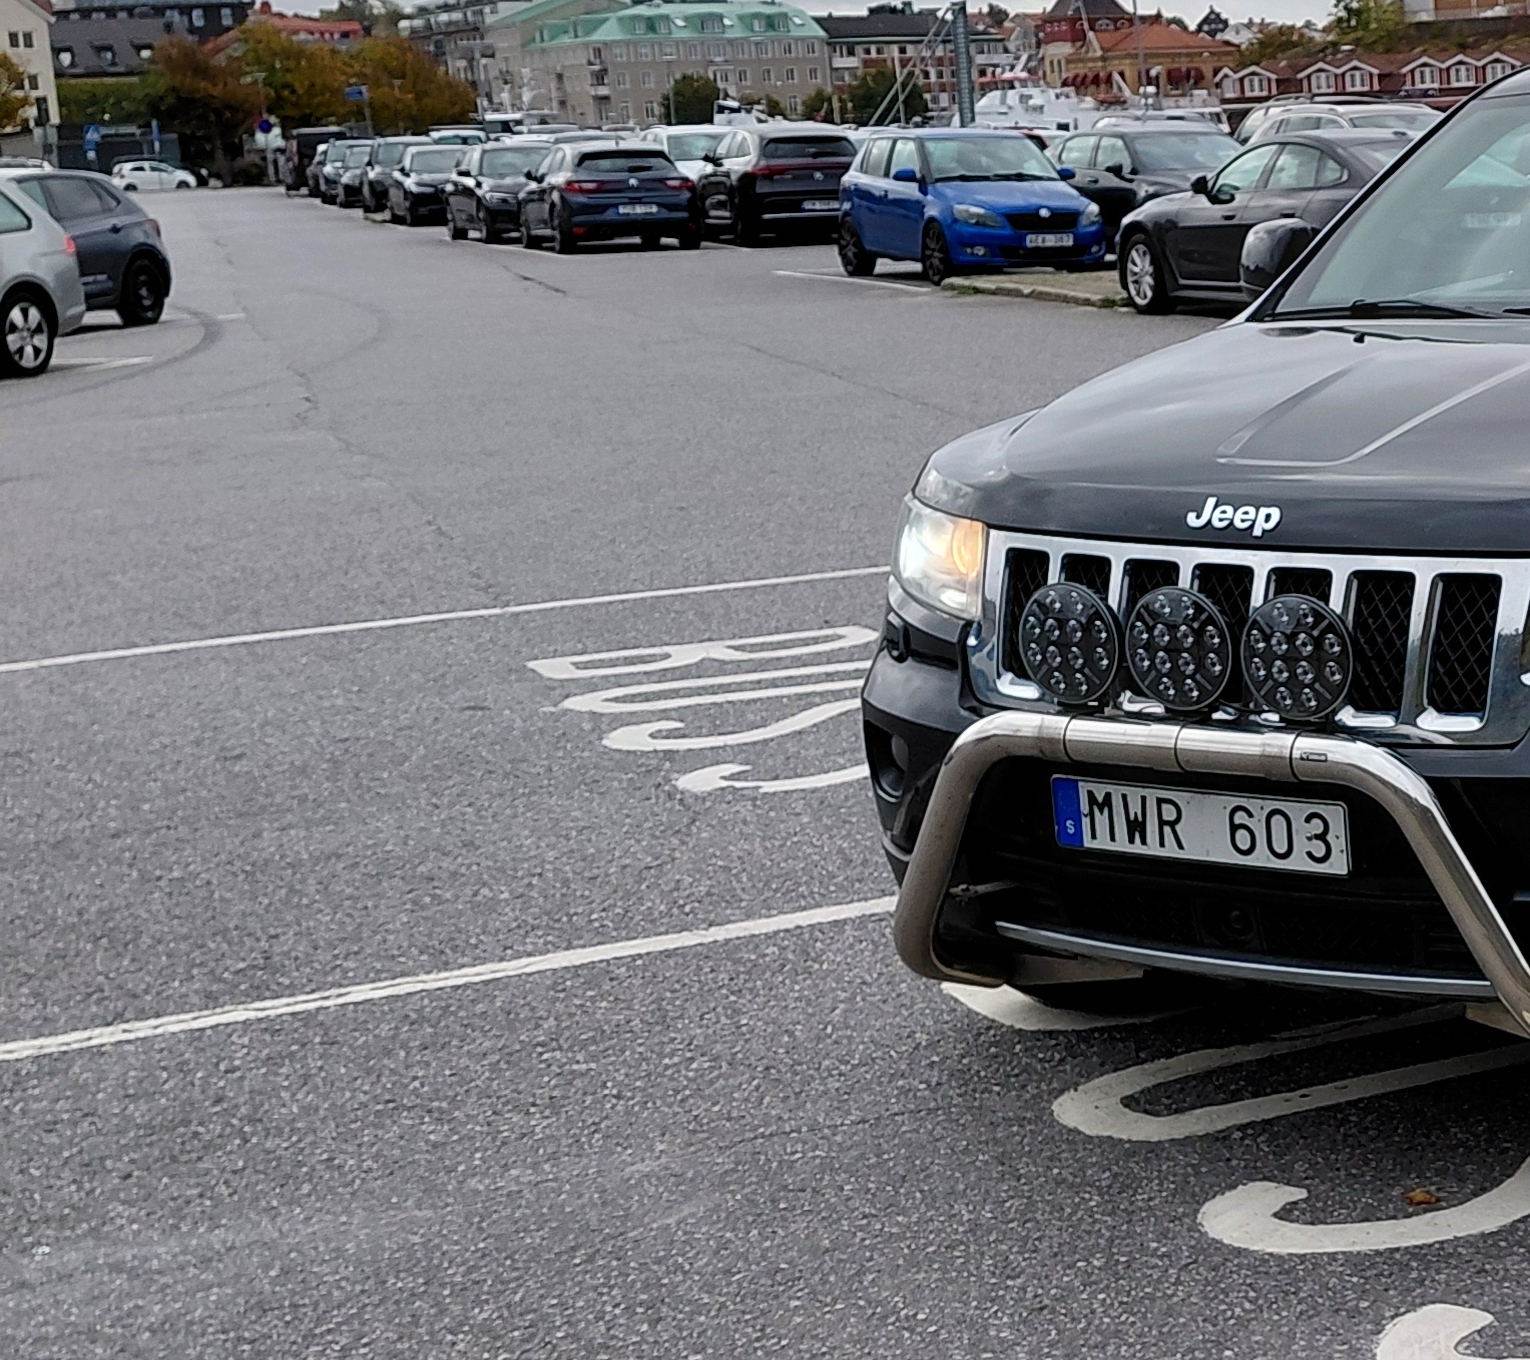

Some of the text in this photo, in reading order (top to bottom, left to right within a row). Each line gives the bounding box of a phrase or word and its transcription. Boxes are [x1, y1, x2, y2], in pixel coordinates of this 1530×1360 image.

[1186, 496, 1281, 537] Jeep
[1065, 819, 1076, 835] S
[1086, 788, 1333, 865] MWR 603
